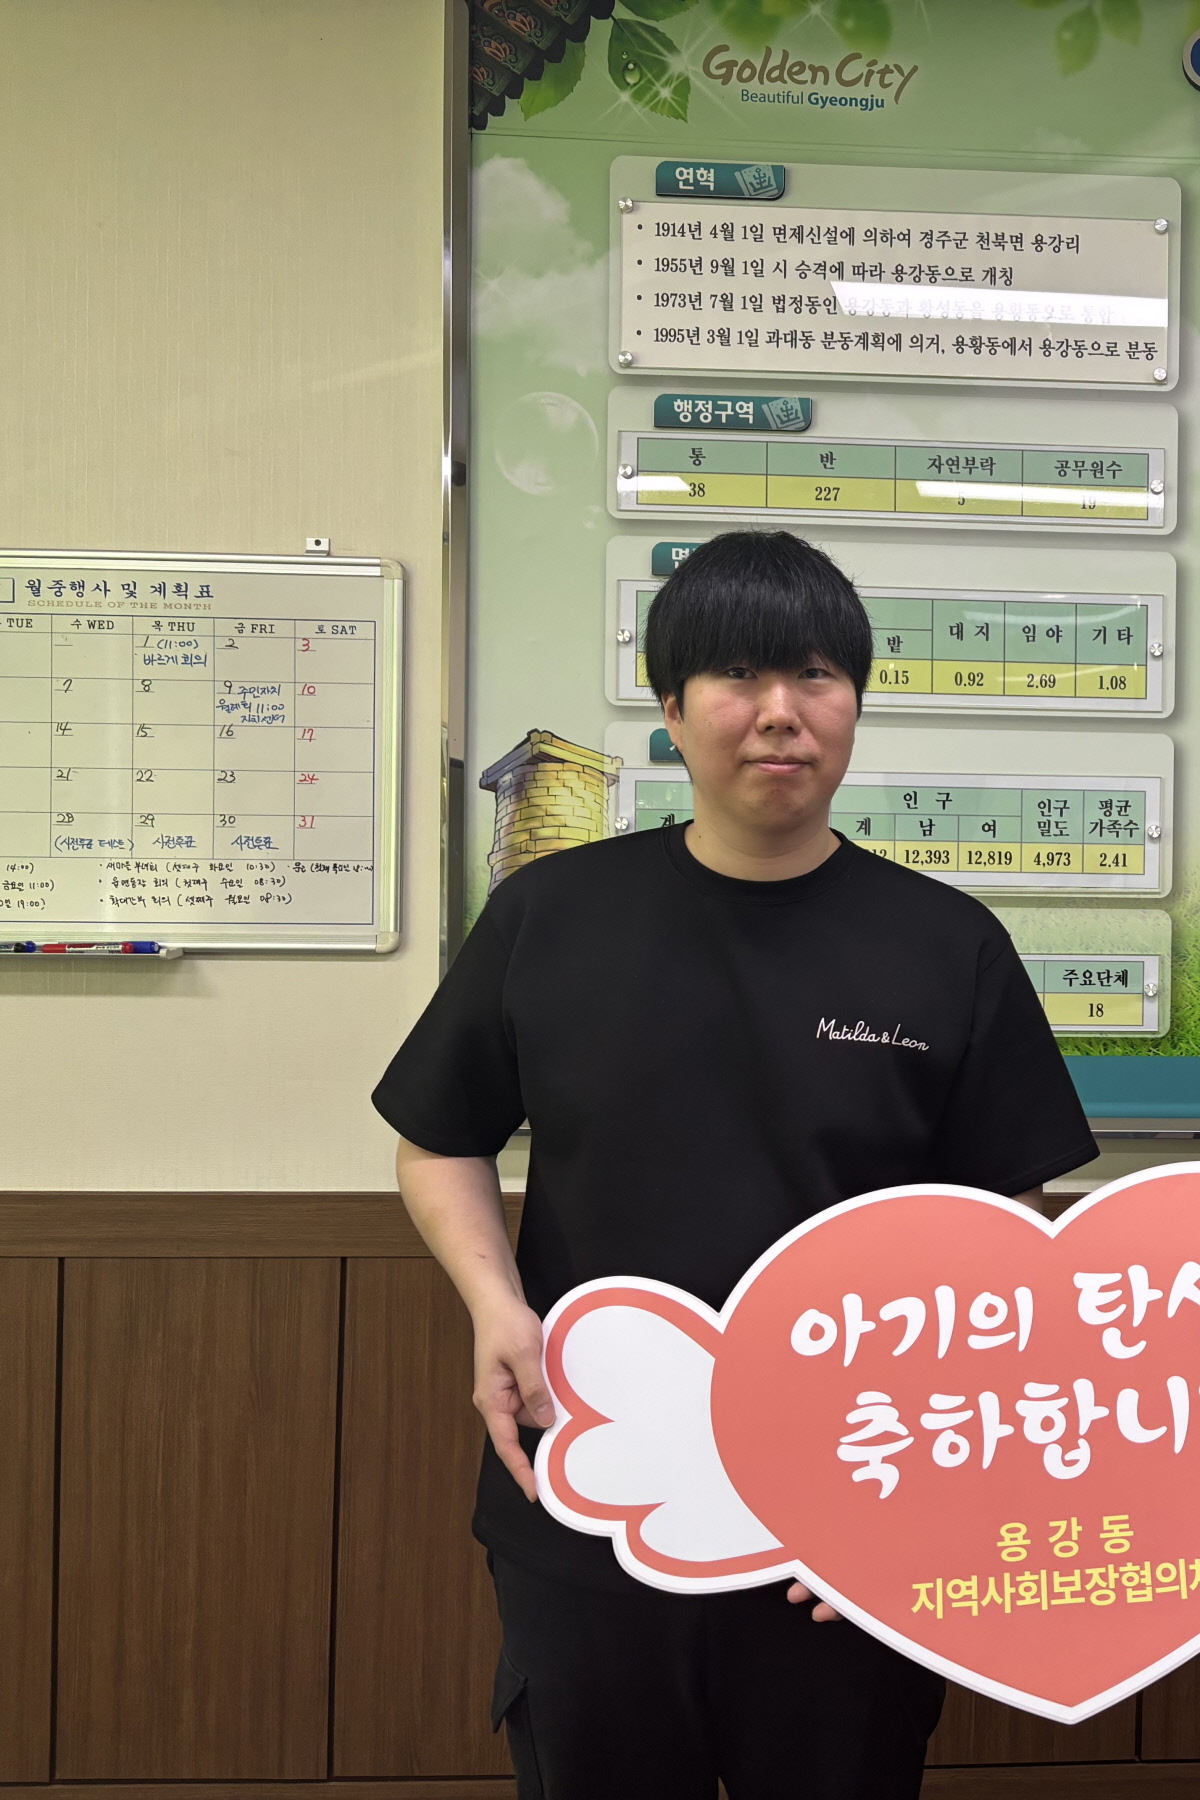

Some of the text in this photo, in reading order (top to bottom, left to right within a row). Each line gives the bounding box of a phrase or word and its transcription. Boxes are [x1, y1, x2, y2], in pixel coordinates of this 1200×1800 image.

[703, 44, 918, 108] Golden City
[742, 89, 884, 111] Beautiful Gyeongju
[676, 167, 714, 190] 연혁
[655, 221, 1079, 254] 1914년 4월 1일 면제신설에 의하여 경주군 천북면 용강리
[655, 256, 1012, 286] 1955년 9월 1일 시 승격에 따라 용강동으로 개칭
[654, 292, 837, 314] 1973년 7월 1일 법정동인
[654, 327, 1158, 360] 1995년 3월 1일 과대동 분동계획에 의거, 용황동에서 용강동으로 분동
[674, 399, 753, 423] 행정구역
[689, 448, 1122, 479] 통 반 자연부락 공무원수
[689, 483, 840, 501] 38 227
[25, 579, 213, 600] 월중행사 및 계획표
[28, 600, 102, 608] SCHEDULE
[7, 618, 356, 634] TUE 수 WED 목 THU 금 FRI SAT
[887, 635, 903, 653] 밭
[301, 684, 316, 695] 10
[880, 670, 1126, 690] 0.15 0.92 2.69 1.08
[135, 770, 154, 782] 22
[1038, 799, 1070, 817] 인구
[1099, 799, 1131, 817] 평균
[219, 815, 236, 825] 30
[856, 817, 996, 838] 계 남 여
[1037, 819, 1069, 837] 밀도
[1089, 819, 1139, 838] 가족수
[905, 850, 1127, 867] 12,393 12,819 4,973 2.41
[1063, 969, 1128, 987] 주요단체
[1089, 1003, 1103, 1017] 18
[816, 1017, 880, 1042] Matilda
[892, 1024, 929, 1051] Leon
[790, 1285, 1036, 1367] 아기의
[996, 1514, 1134, 1562] 용강동
